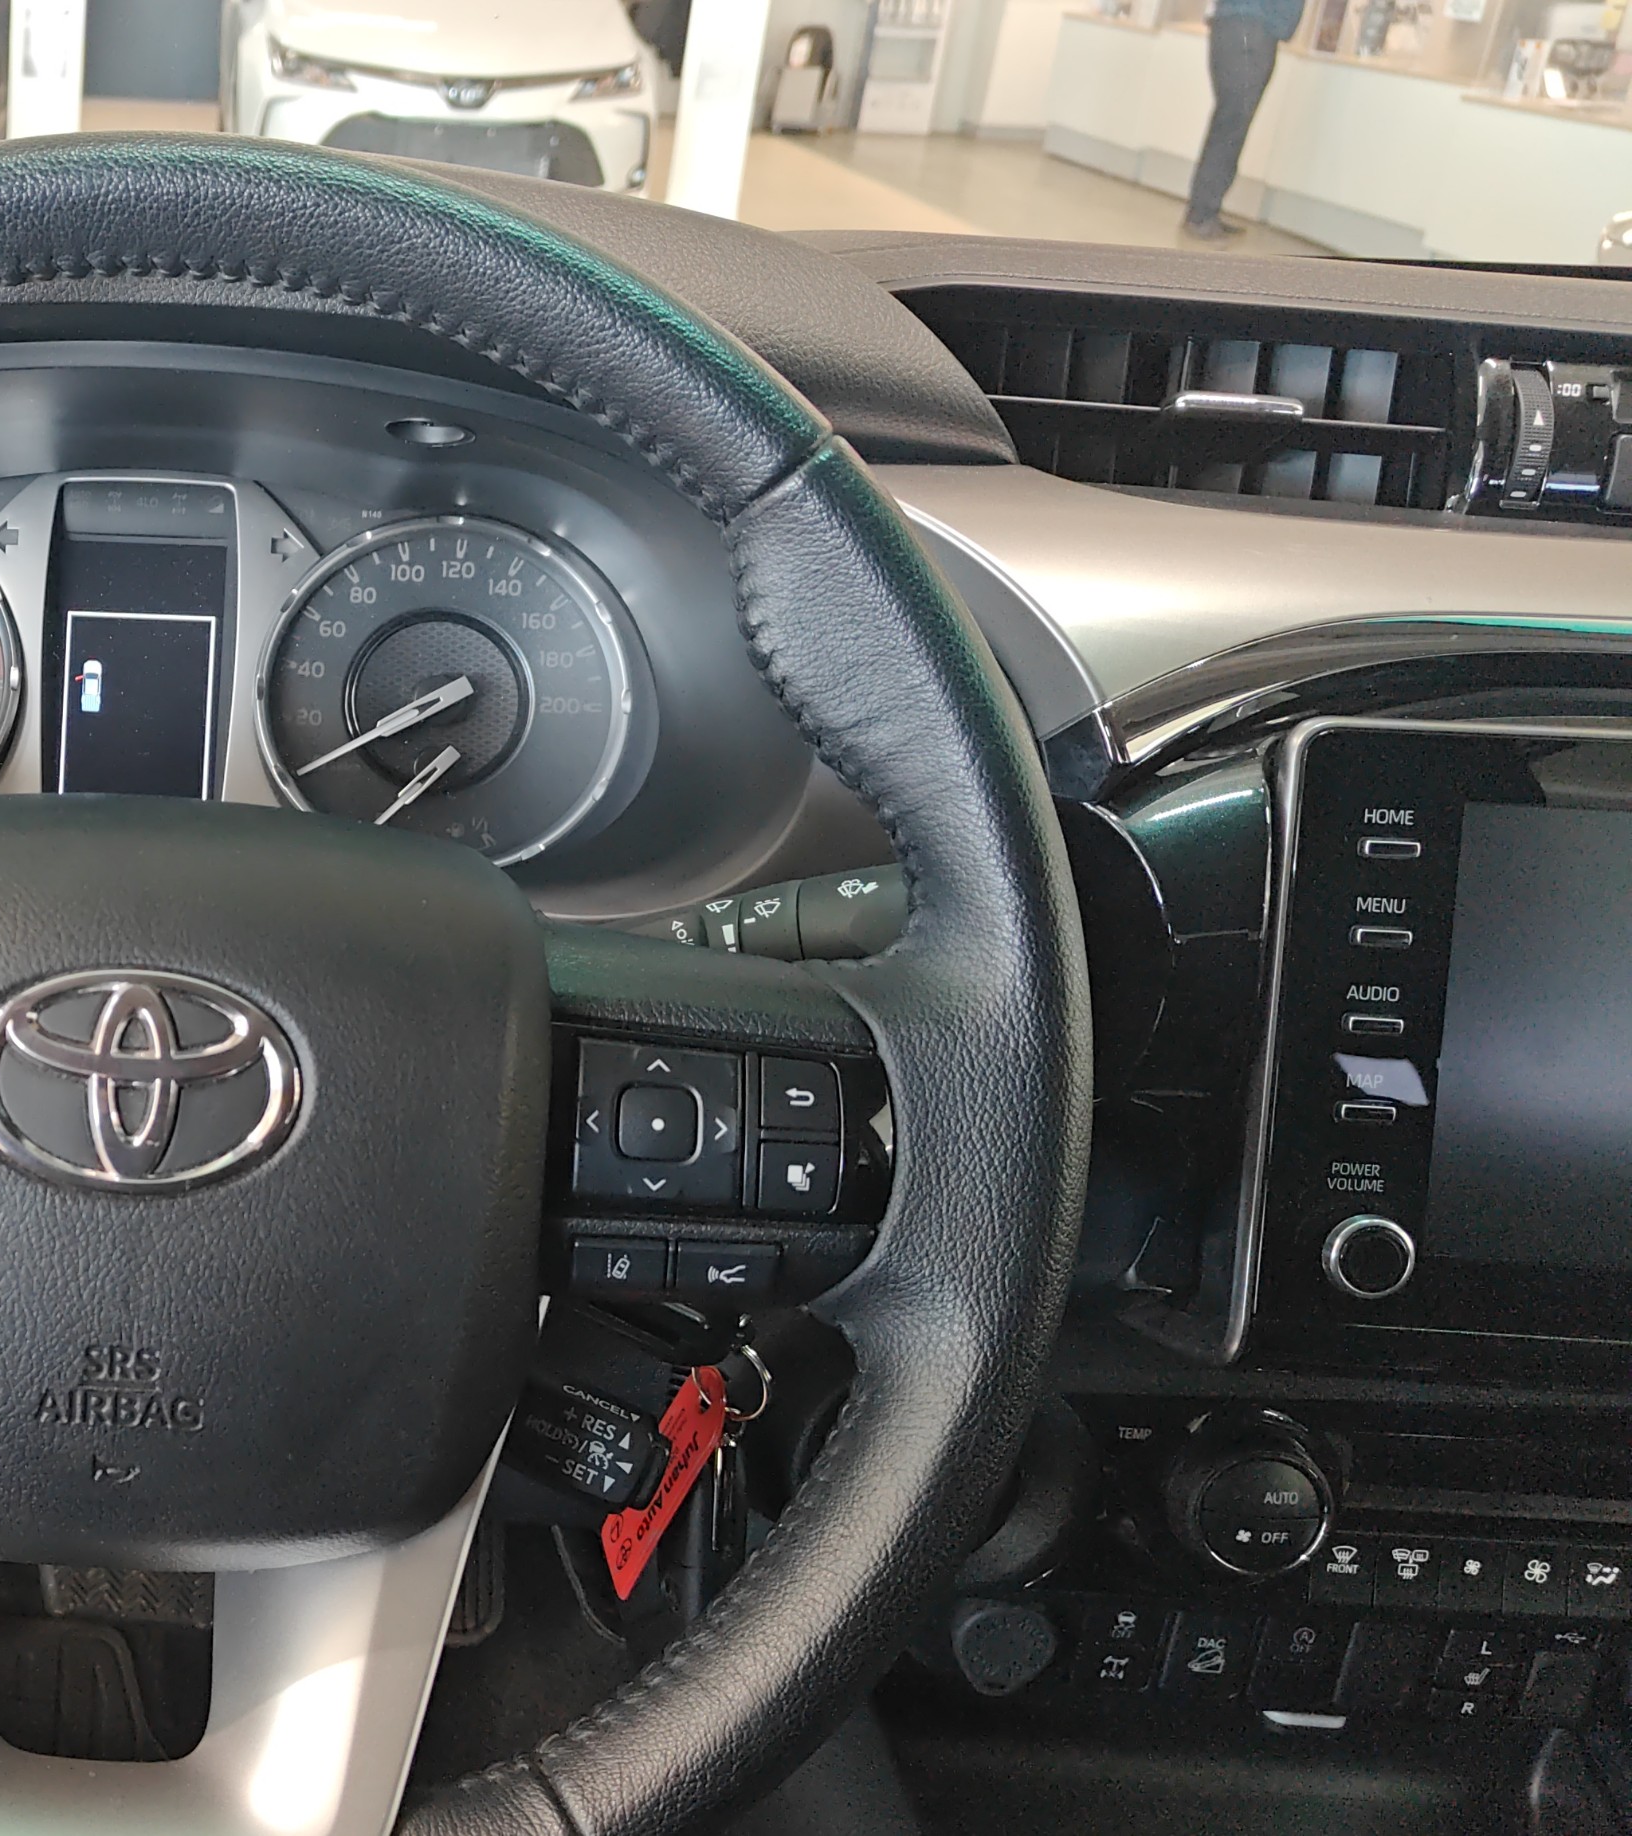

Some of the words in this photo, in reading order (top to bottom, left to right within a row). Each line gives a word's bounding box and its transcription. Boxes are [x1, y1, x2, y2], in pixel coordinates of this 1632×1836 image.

[390, 563, 425, 582] 100
[442, 561, 475, 578] 120
[350, 587, 377, 604] 80
[488, 578, 521, 596] 140
[319, 620, 346, 638] 60
[522, 612, 556, 630] 160
[540, 650, 574, 668] 180
[298, 661, 325, 678] 40
[540, 698, 580, 714] 200
[297, 708, 322, 727] 20
[1363, 808, 1415, 826] HOME
[1356, 897, 1406, 914] MENU
[1346, 985, 1400, 1003] AUDIO
[1346, 1073, 1384, 1089] MAP
[1331, 1162, 1380, 1177] POWER
[1327, 1177, 1385, 1193] VOLUME
[82, 1344, 162, 1382] SRS
[35, 1388, 205, 1432] AIRBAG
[562, 1385, 629, 1419] CANCEL
[525, 1416, 563, 1440] HOLD
[581, 1412, 618, 1440] RES
[1118, 1426, 1152, 1441] TEMP
[665, 1431, 700, 1494] Juhan
[561, 1460, 599, 1486] SET
[1263, 1491, 1299, 1506] AUTO
[636, 1495, 665, 1542] Auto
[1261, 1531, 1289, 1543] OFF
[1326, 1562, 1358, 1575] FRONT
[1197, 1638, 1226, 1649] DAC
[1480, 1640, 1492, 1655] L
[1460, 1701, 1475, 1715] R
